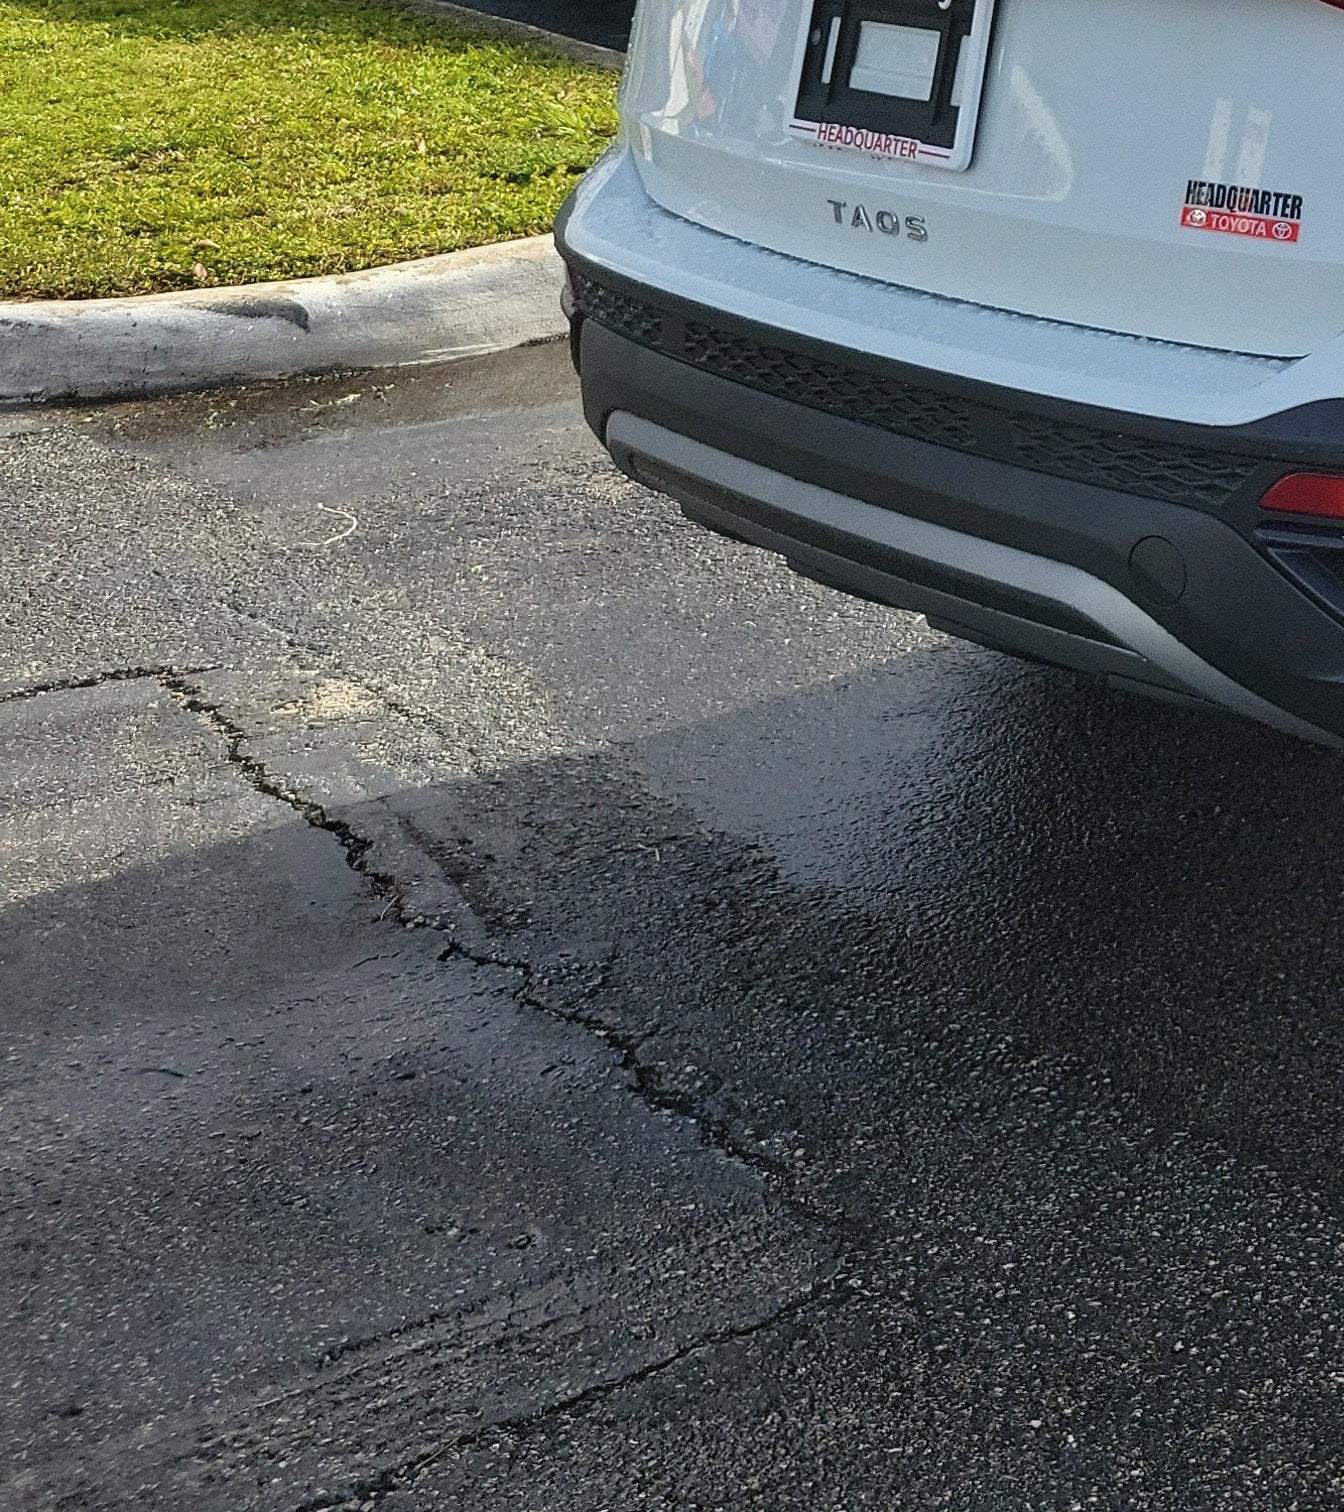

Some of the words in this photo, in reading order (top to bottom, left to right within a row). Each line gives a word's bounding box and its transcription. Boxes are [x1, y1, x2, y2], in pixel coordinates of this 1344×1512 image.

[816, 122, 920, 160] HEADQUARTER
[826, 198, 929, 242] TAOS
[1184, 179, 1304, 221] HEADQUARTER
[1210, 213, 1268, 237] TOYOTA
